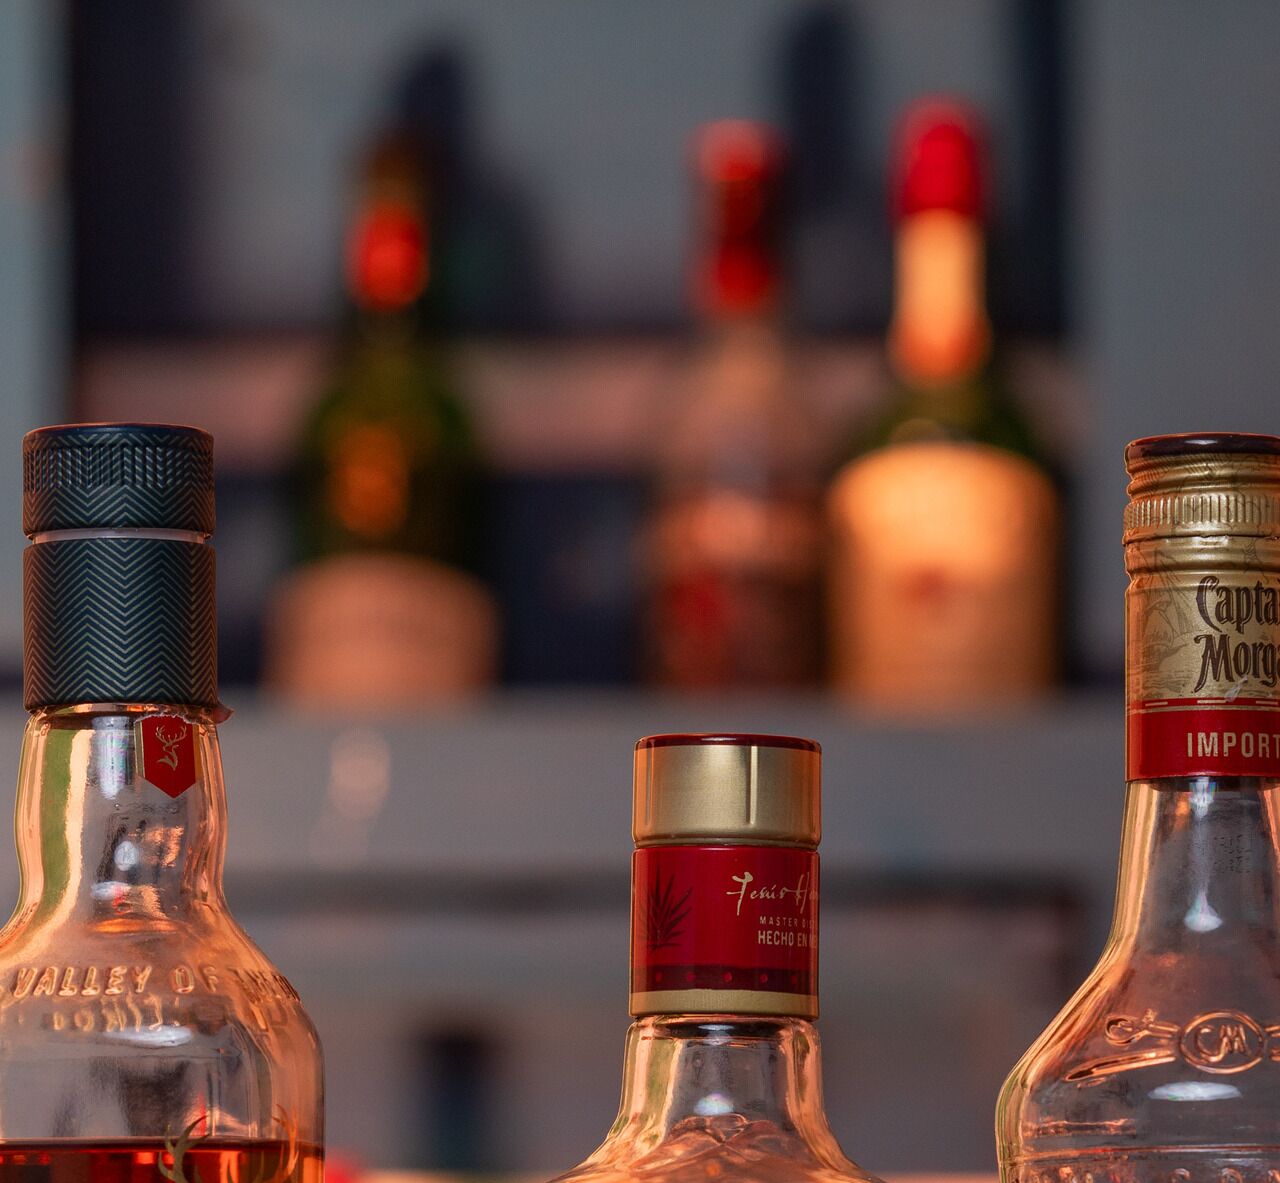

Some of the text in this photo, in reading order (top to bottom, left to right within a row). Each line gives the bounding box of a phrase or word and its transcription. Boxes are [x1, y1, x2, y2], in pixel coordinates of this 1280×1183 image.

[759, 915, 798, 927] MASTER
[758, 930, 794, 947] HECHO
[797, 933, 808, 947] EN
[13, 966, 152, 998] VALLEY
[173, 965, 220, 994] OF
